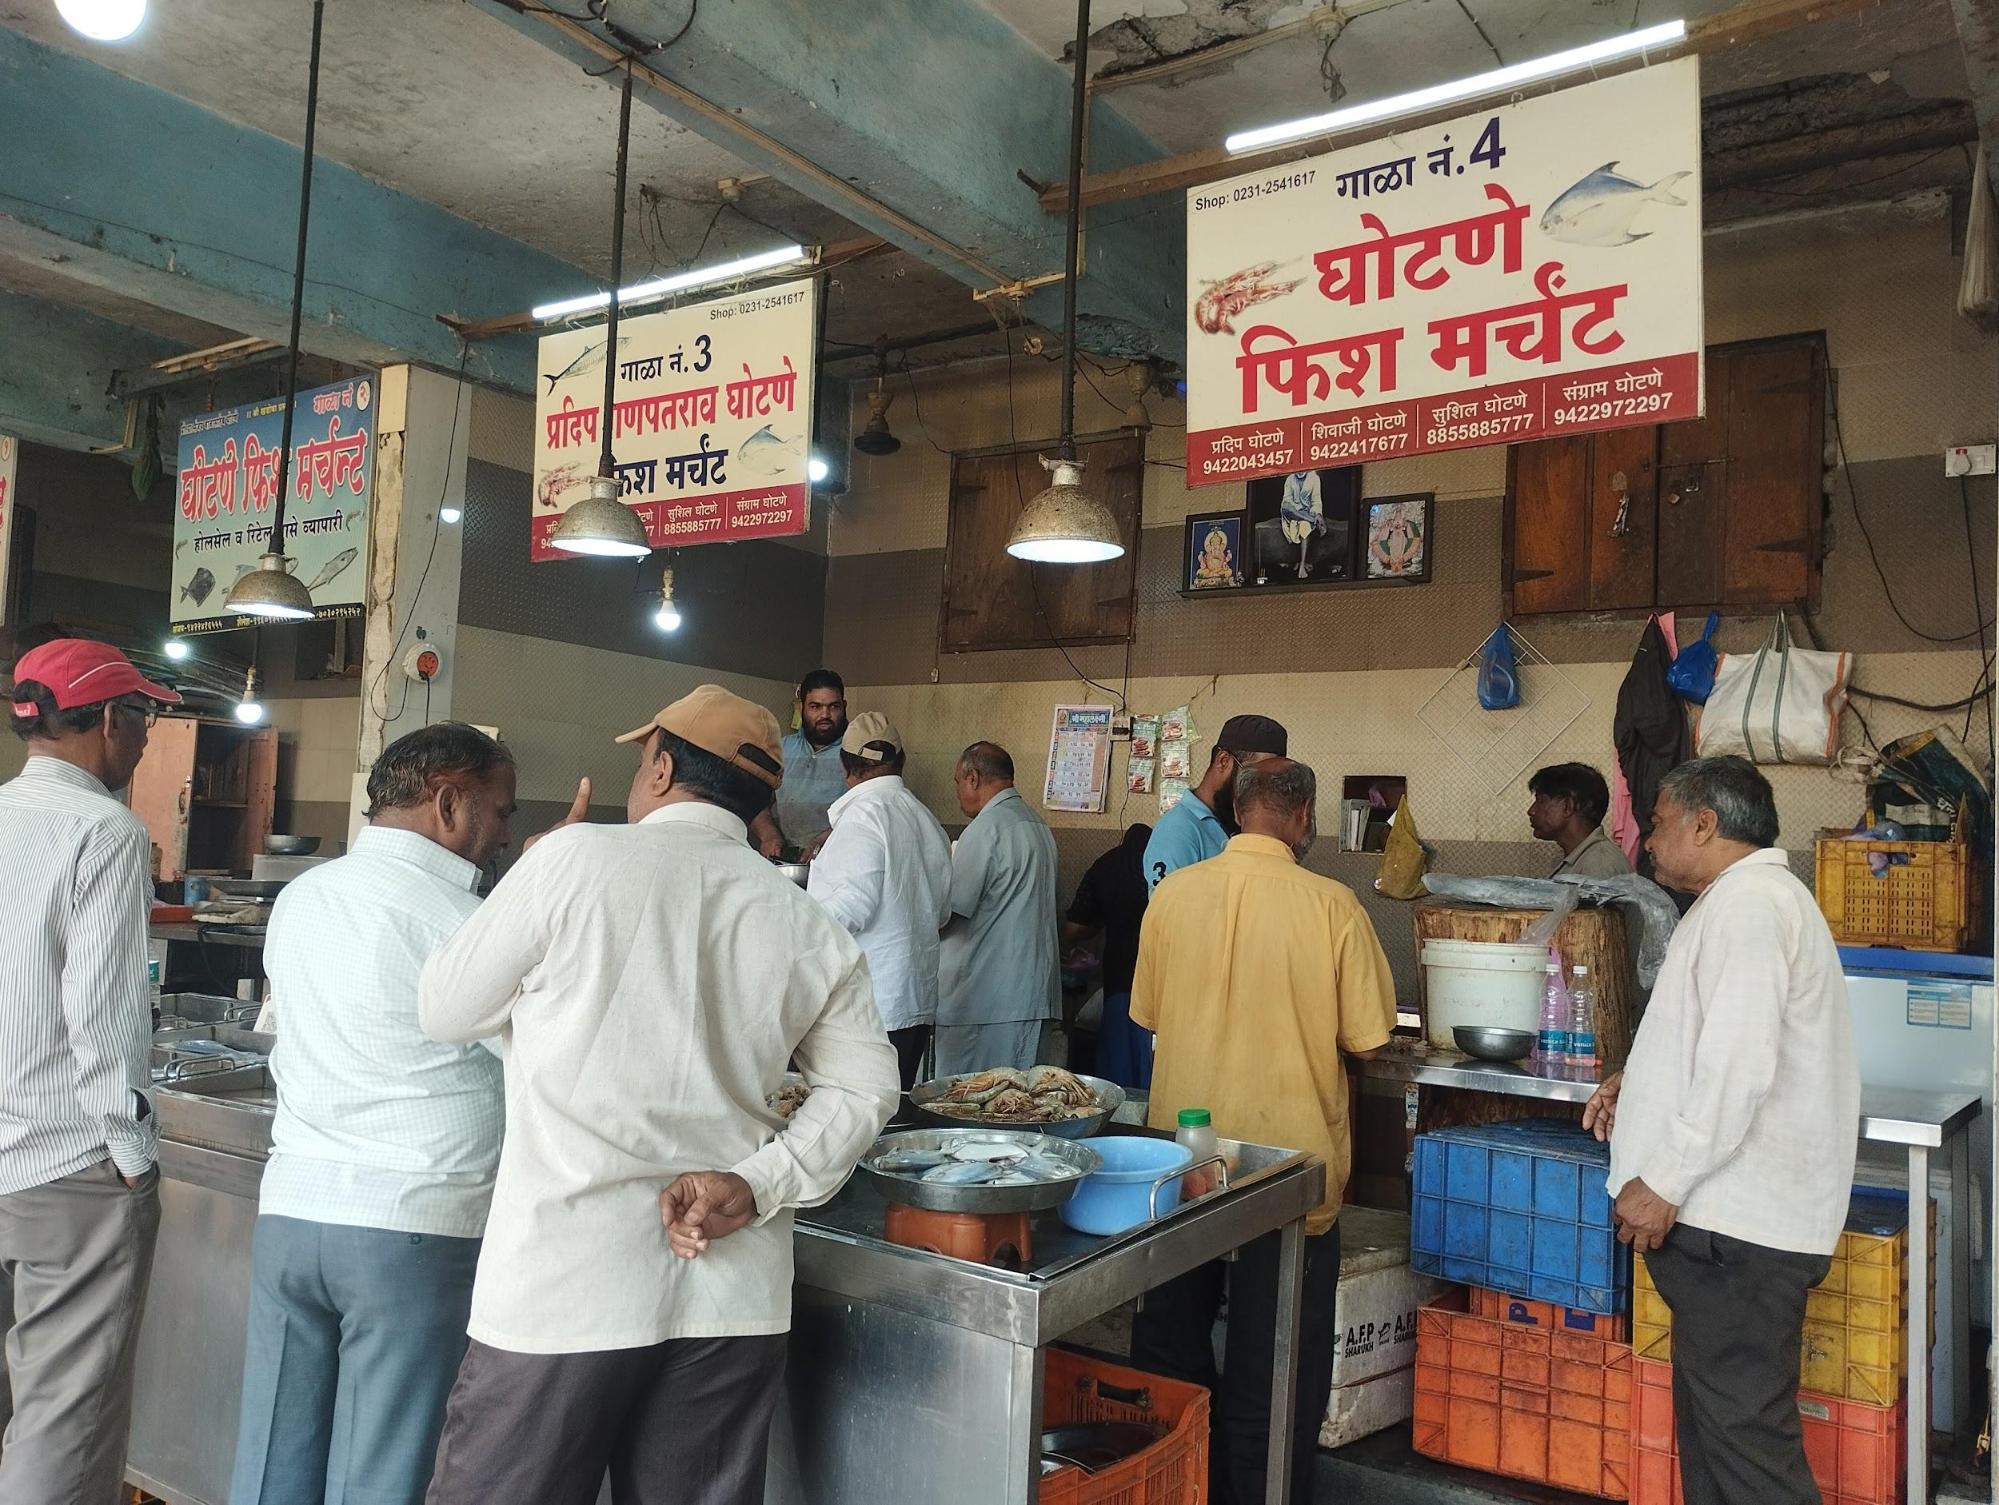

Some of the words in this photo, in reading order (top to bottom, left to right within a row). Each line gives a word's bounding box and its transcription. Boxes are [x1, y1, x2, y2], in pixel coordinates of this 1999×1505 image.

[1195, 191, 1230, 212] Shop:
[1233, 171, 1317, 202] 0231-2541617
[1336, 155, 1416, 200] गाळा
[1314, 183, 1531, 306] घोटणे
[710, 307, 737, 320] Shop:
[739, 292, 805, 315] 0231-2541617
[1235, 324, 1404, 414] फिश
[1428, 261, 1628, 377] मर्चंट
[621, 356, 663, 383] गाळा
[1563, 379, 1609, 403] संग्राम
[1615, 367, 1663, 393] घोटणे
[546, 395, 600, 450] प्रदिप
[726, 355, 797, 420] घोटणे
[1432, 401, 1479, 427] सुशिल
[1484, 391, 1528, 414] घोटणे
[1553, 392, 1673, 425] 9422972297
[1211, 434, 1243, 456] प्रदिप
[1248, 428, 1284, 450] घोटणे
[1311, 418, 1362, 442] शिवाजी
[1366, 410, 1408, 434] घोटणे
[1426, 413, 1534, 446] 8855885777
[666, 433, 728, 490] मर्चंट
[1203, 449, 1294, 476] 9422043457
[1310, 433, 1409, 462] 9422417677
[180, 437, 238, 522] घोटणे
[668, 508, 692, 521] सुशिल
[695, 503, 718, 516] घोटणे
[736, 497, 760, 512] संग्राम
[763, 492, 788, 506] घोटणे
[194, 530, 231, 554] होलसेल
[235, 532, 242, 545] व
[247, 523, 272, 544] रिटेल
[303, 508, 343, 536] व्यापारी
[664, 518, 722, 535] 8855885777
[731, 510, 792, 528] 9422972297
